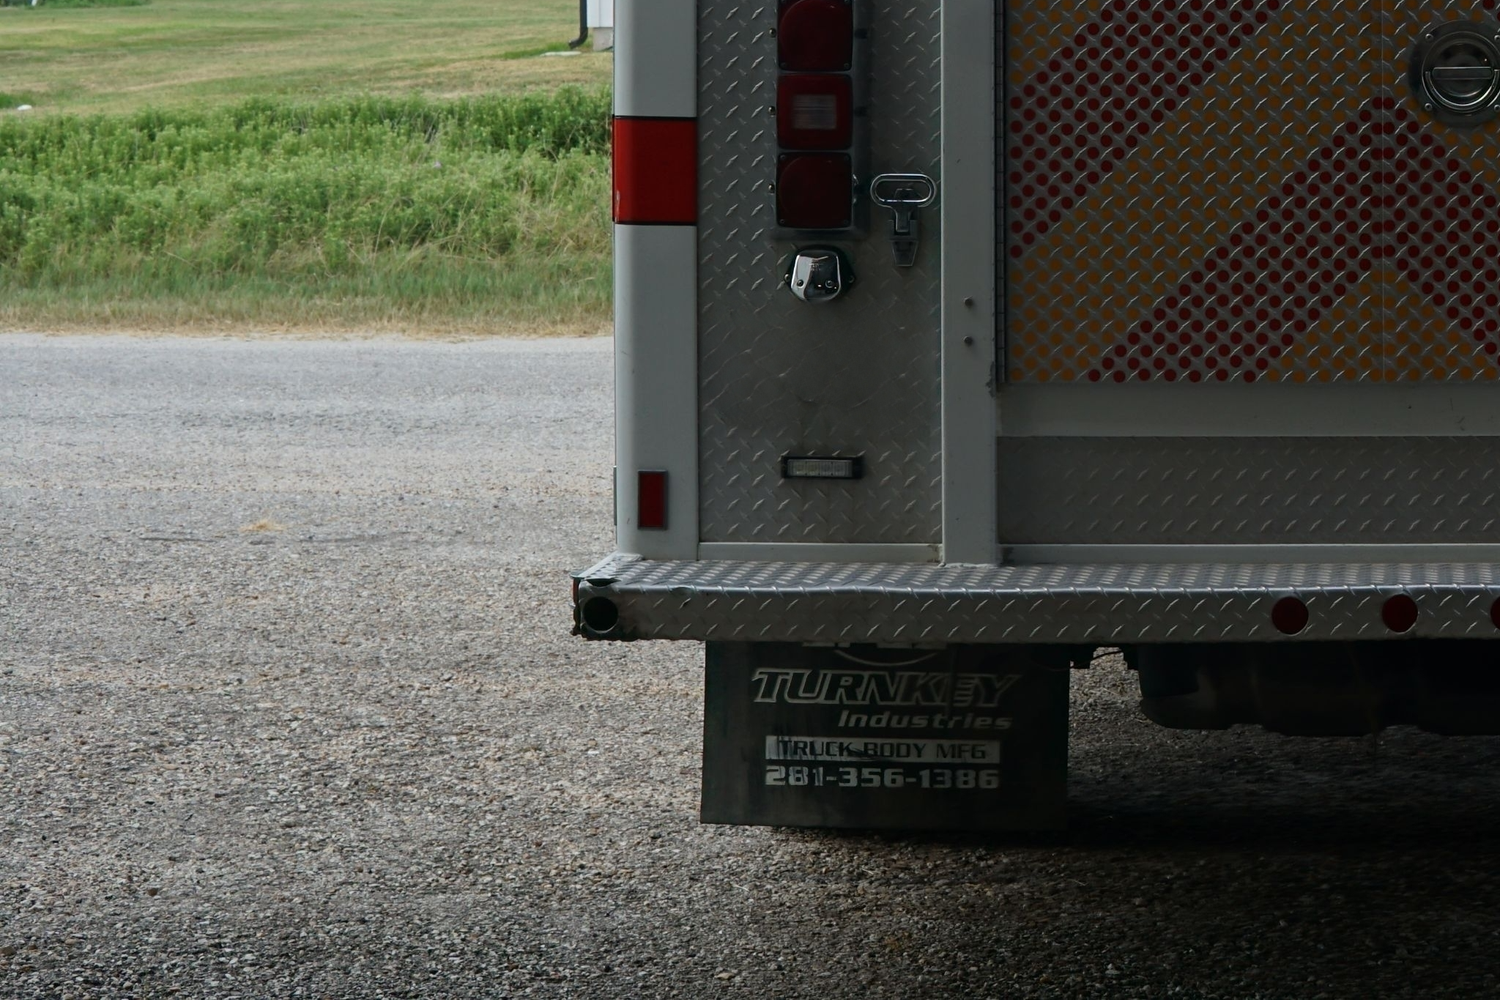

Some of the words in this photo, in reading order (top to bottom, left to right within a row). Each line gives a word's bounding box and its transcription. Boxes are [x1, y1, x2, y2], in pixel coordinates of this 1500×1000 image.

[751, 668, 1022, 707] TURNKEY
[838, 710, 1013, 730] Industries
[778, 740, 853, 758] TRUCK
[864, 741, 926, 759] BODY
[936, 742, 987, 759] MFG
[765, 765, 1000, 789] 281-356-1386
